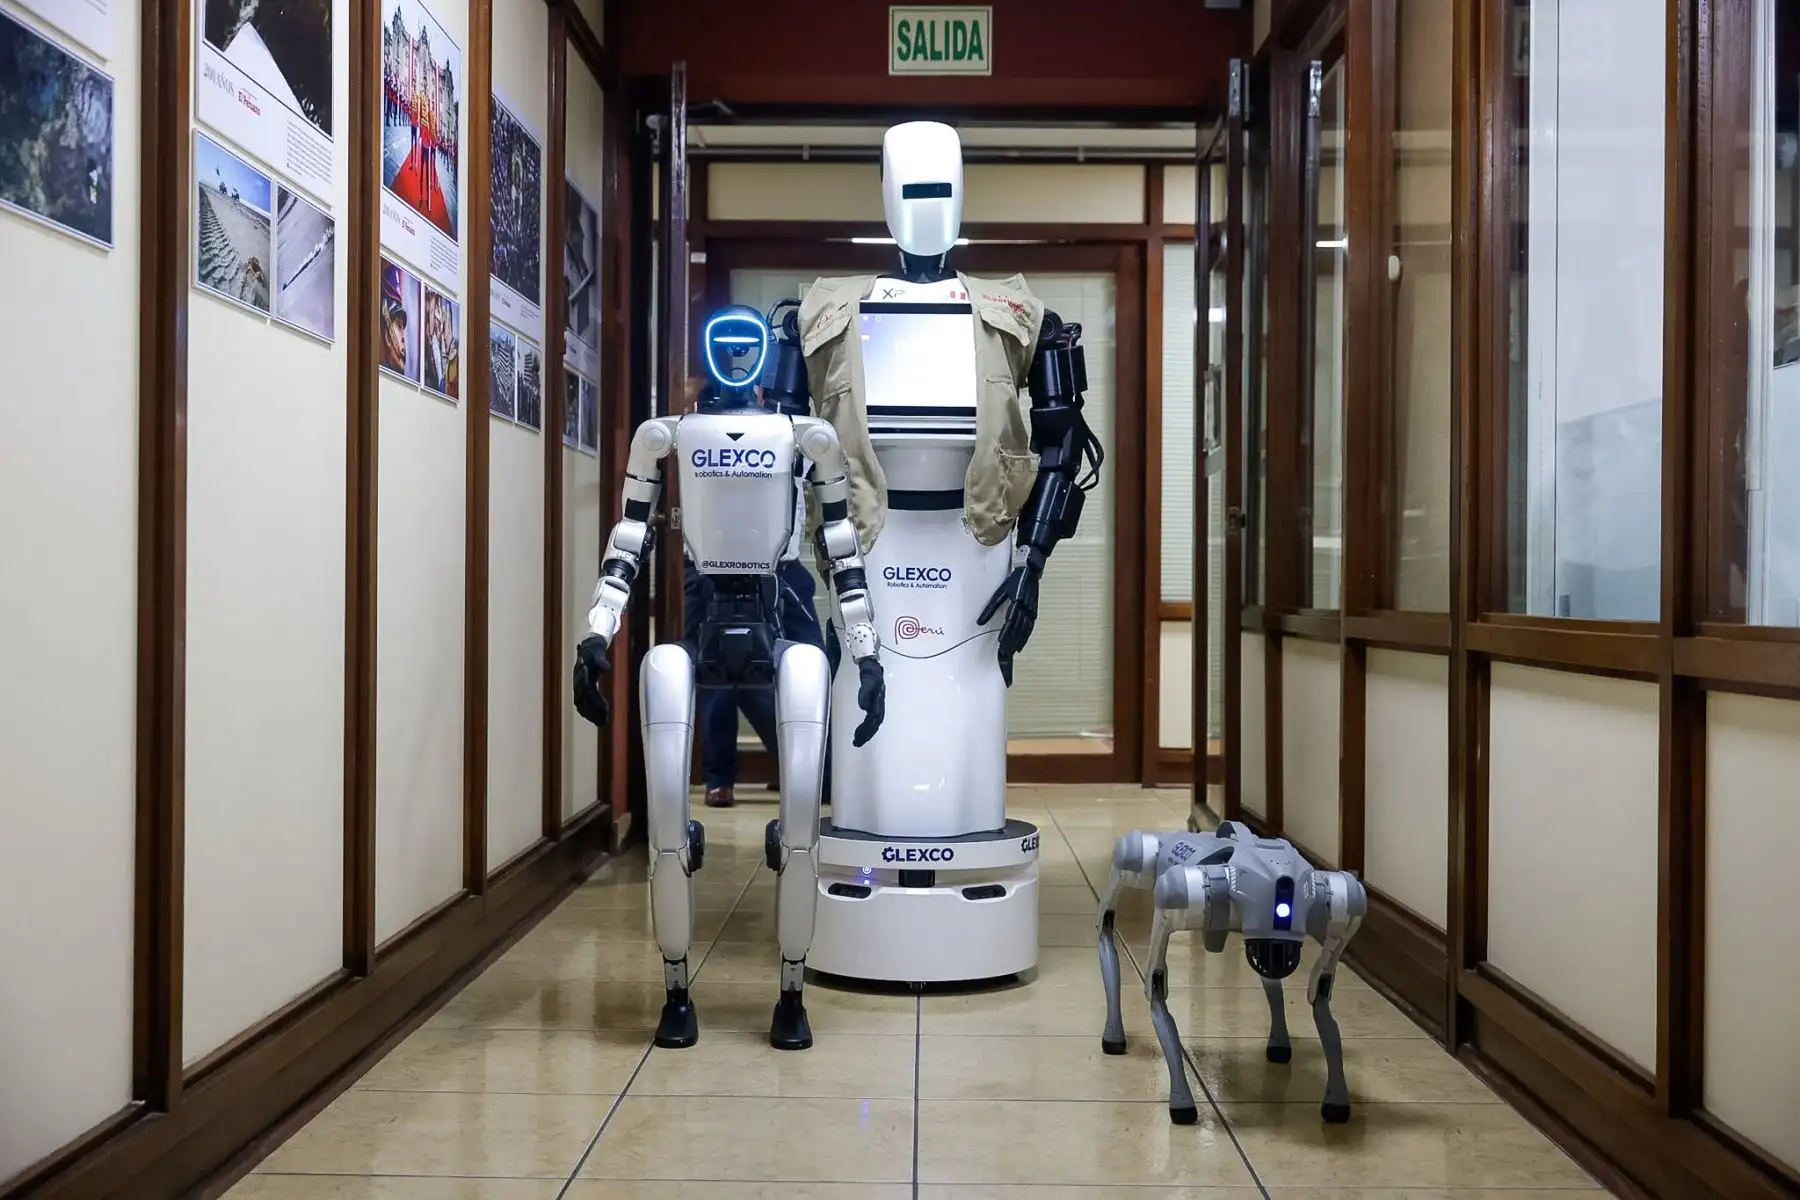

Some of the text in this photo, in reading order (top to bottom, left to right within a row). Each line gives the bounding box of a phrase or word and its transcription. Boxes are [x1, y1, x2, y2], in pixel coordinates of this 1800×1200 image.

[897, 19, 984, 62] SALIDA
[691, 448, 776, 468] GLEXCO
[724, 470, 730, 478] &
[731, 470, 773, 479] Automation
[701, 560, 770, 569] @GLEXROBOTICS
[883, 566, 952, 582] GLEXCO
[881, 846, 954, 863] GLEXCO
